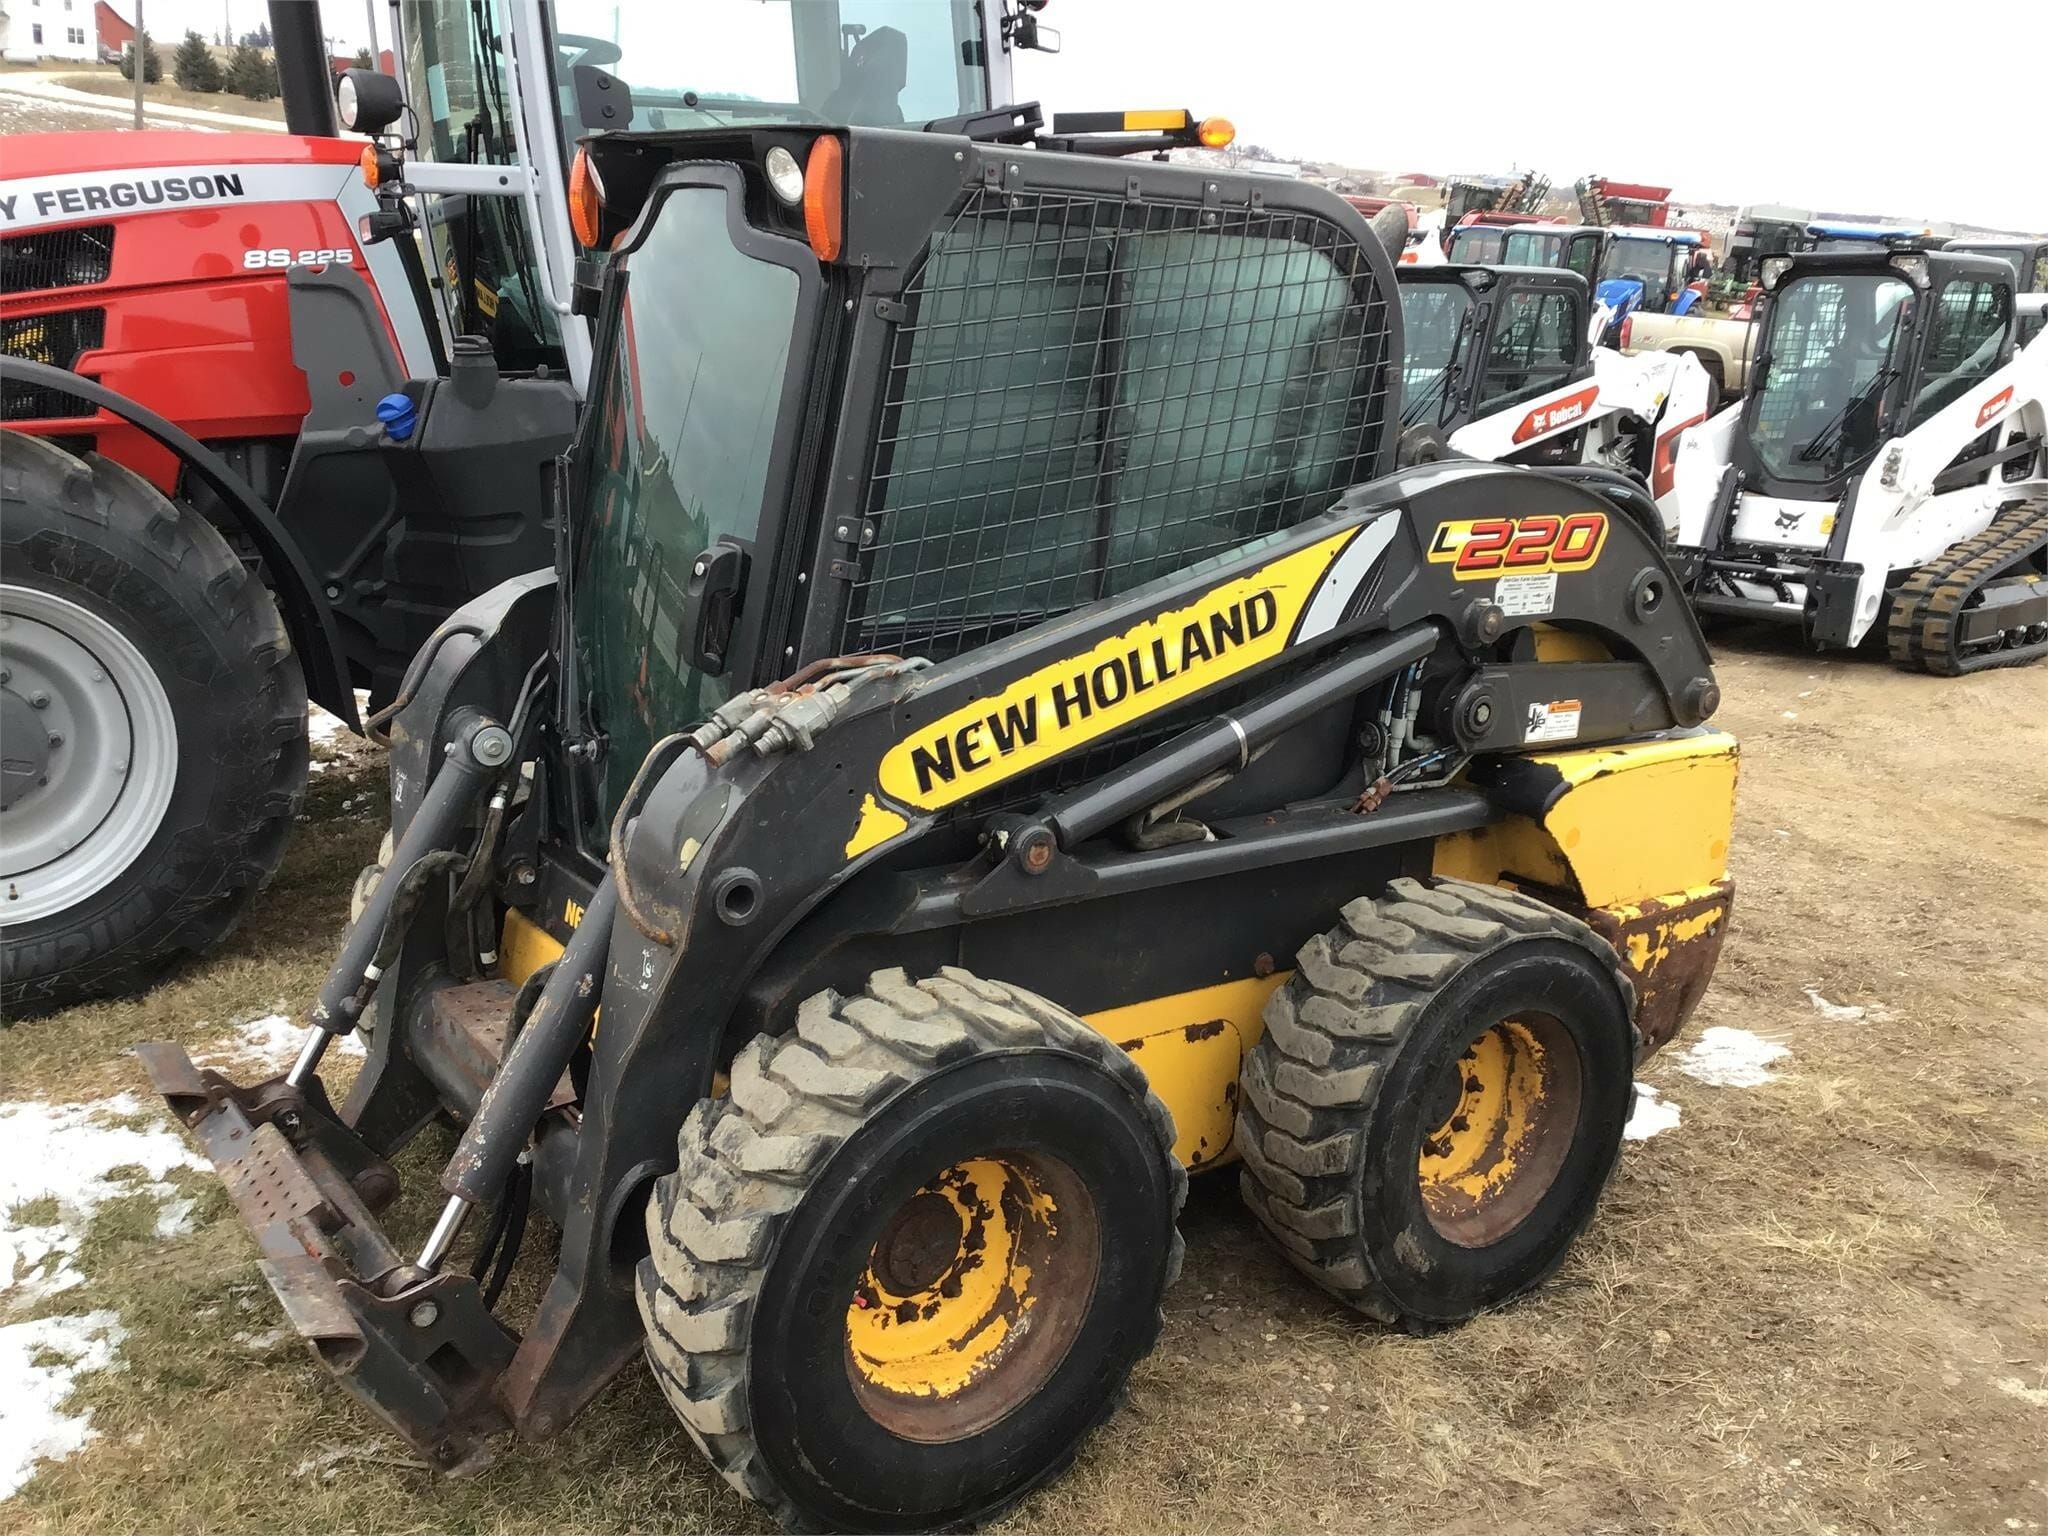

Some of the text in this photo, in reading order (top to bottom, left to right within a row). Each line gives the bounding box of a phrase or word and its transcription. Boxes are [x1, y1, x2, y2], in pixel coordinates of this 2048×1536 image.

[33, 174, 244, 216] FERGUSON
[243, 248, 353, 269] 8S.225
[1430, 513, 1606, 573] L220
[911, 589, 1277, 794] NEW HOLLAND
